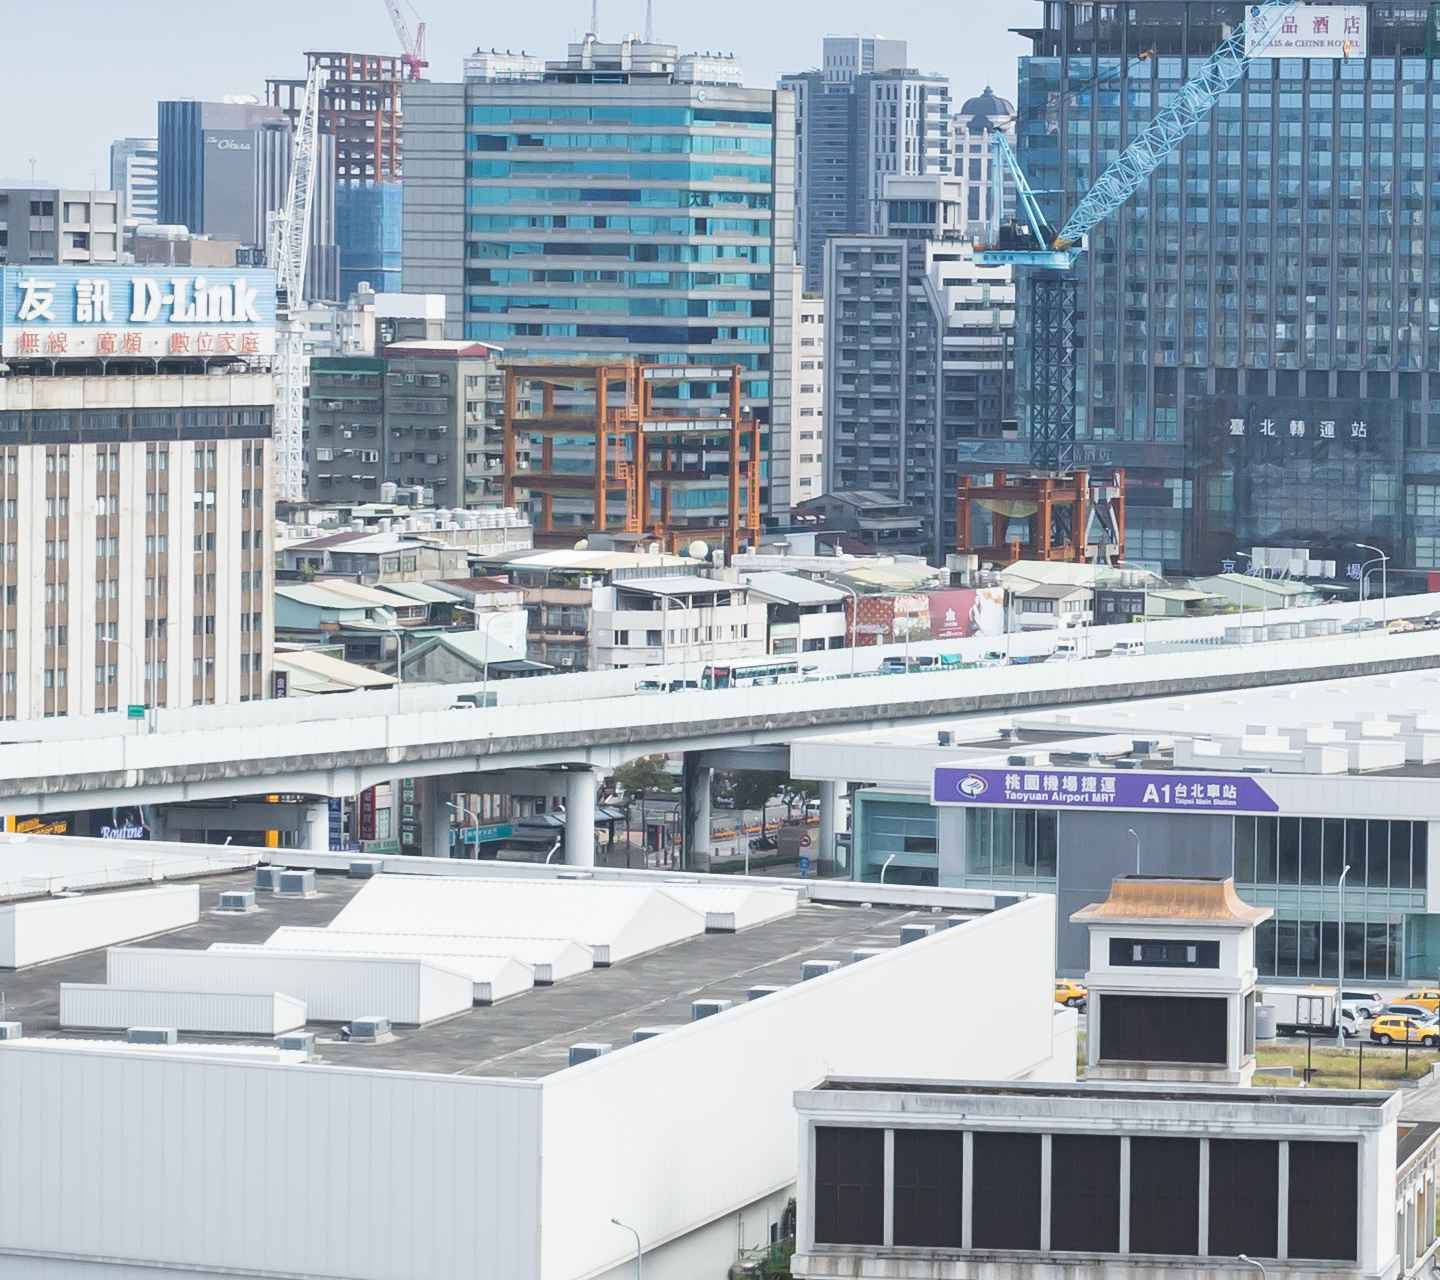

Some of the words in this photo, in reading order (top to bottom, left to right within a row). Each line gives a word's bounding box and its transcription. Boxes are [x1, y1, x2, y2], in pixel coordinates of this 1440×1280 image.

[1295, 39, 1325, 48] CHINE
[218, 139, 251, 150] Okura
[17, 276, 114, 323] 友訊
[129, 276, 261, 322] D-Link
[1229, 419, 1368, 439] 臺北轉運站
[1003, 789, 1048, 802] Taoyuan
[1051, 792, 1089, 803] Airport
[1091, 793, 1116, 803] MRT
[1174, 797, 1194, 806] Taipei
[1195, 798, 1211, 806] Main
[1212, 798, 1237, 806] Station
[1004, 773, 1116, 794] 桃園機場捷運
[1142, 782, 1171, 804] A1
[1174, 782, 1237, 799] 台北車站
